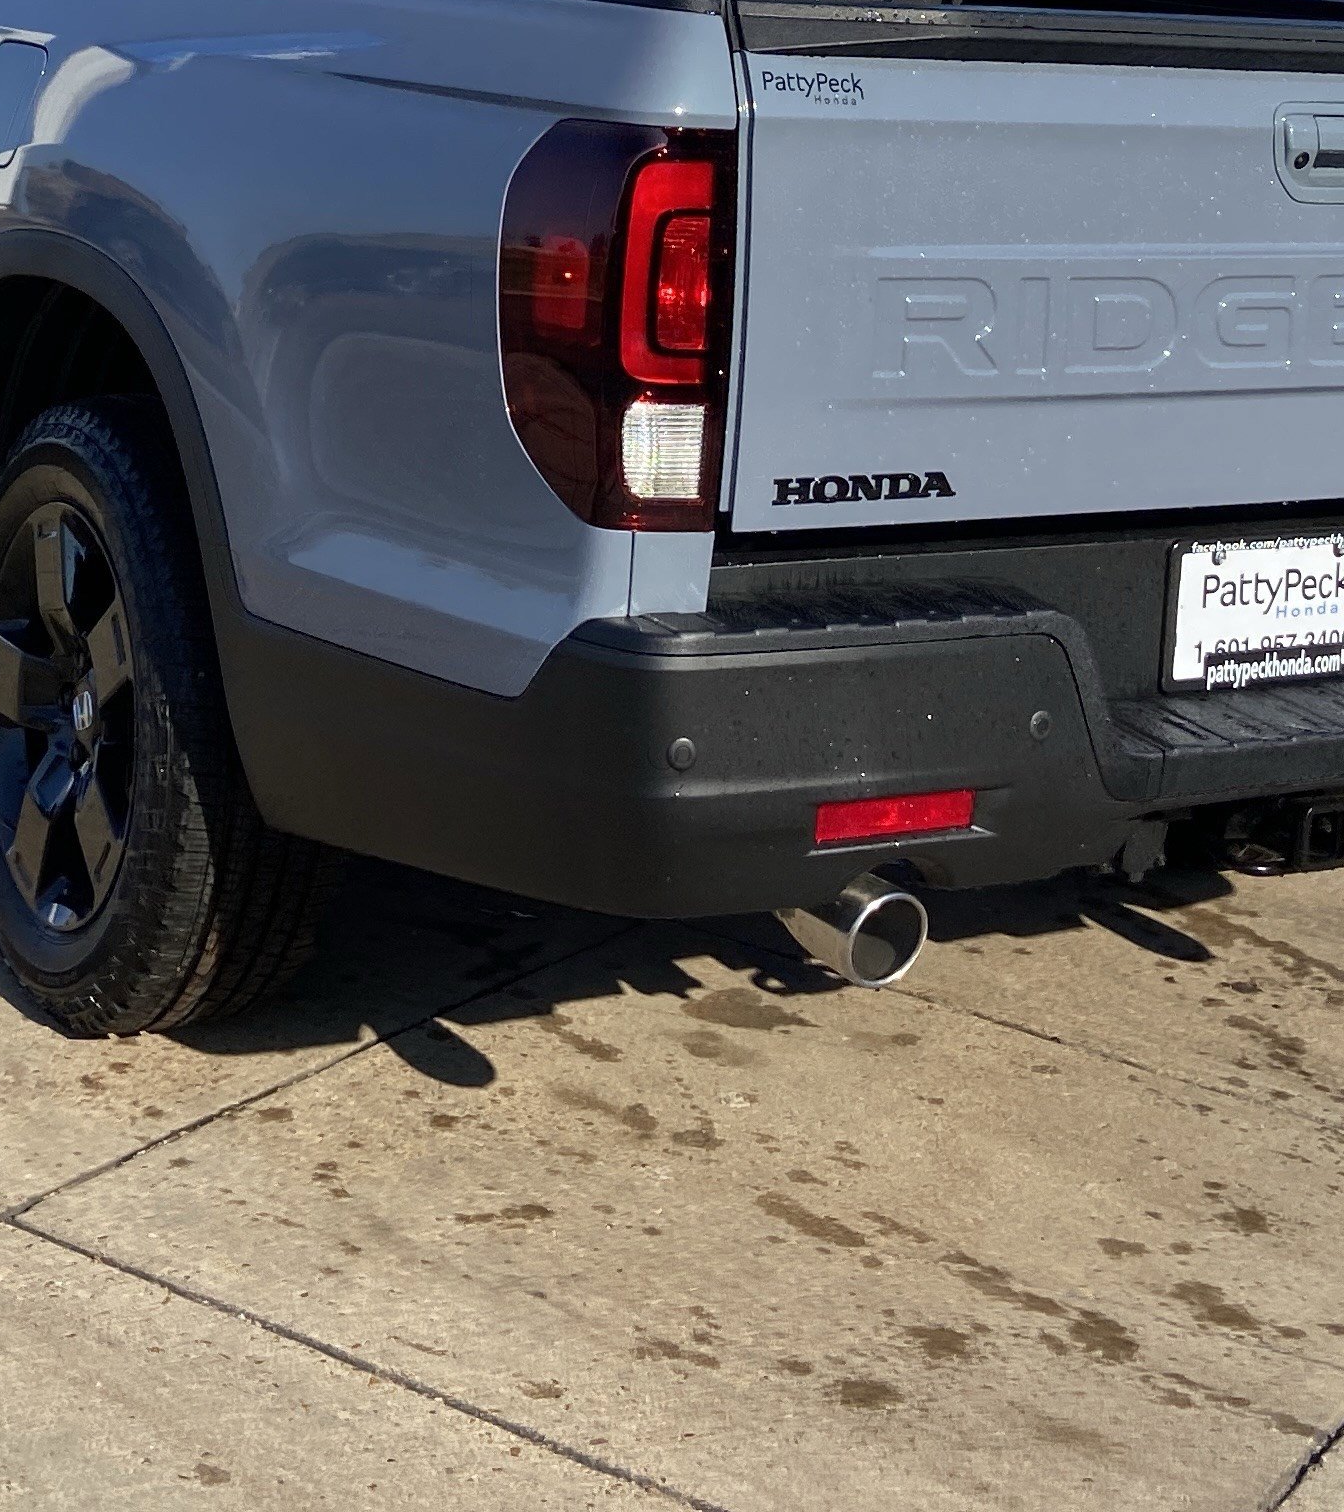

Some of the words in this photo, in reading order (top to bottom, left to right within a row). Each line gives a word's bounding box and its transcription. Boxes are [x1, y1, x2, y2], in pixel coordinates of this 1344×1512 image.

[762, 71, 864, 100] PattyPeck
[813, 95, 857, 106] Honda
[772, 471, 956, 506] HONDA
[1275, 601, 1339, 619] Honda
[1206, 649, 1341, 690] pattypeckhonda.com
